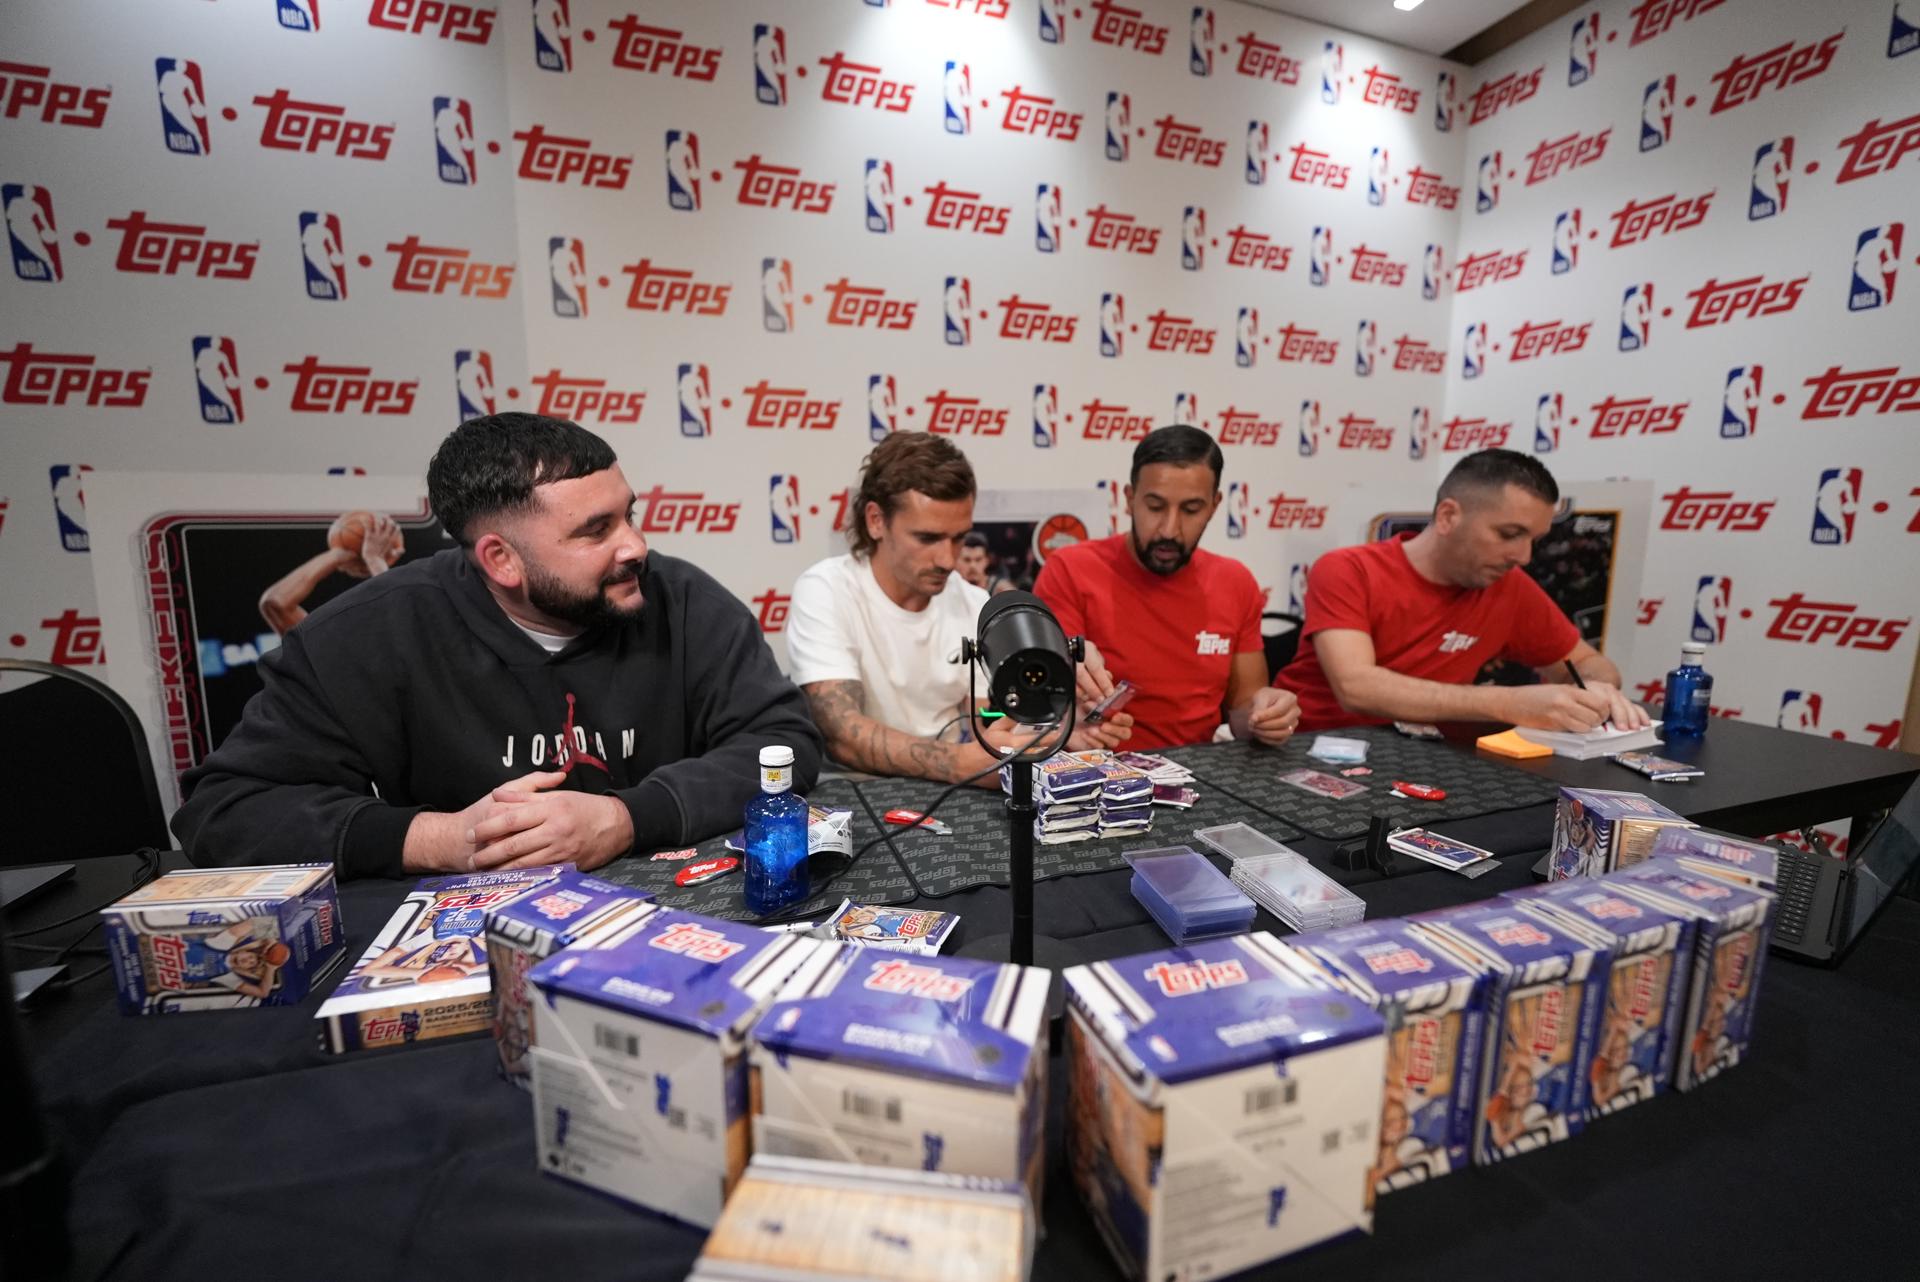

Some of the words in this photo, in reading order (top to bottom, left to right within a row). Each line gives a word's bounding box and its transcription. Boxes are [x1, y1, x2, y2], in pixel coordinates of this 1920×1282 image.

[609, 15, 721, 81] Topps
[1092, 0, 1168, 55] Topps
[0, 62, 111, 128] pps
[819, 52, 914, 113] Topps
[1363, 65, 1420, 113] Topps
[1467, 68, 1542, 126] Topps
[1712, 33, 1842, 115] Topps
[254, 89, 395, 160] Topps
[1001, 85, 1083, 142] Topps
[170, 132, 196, 152] NBA
[514, 125, 634, 190] Topps
[1155, 115, 1226, 167] Topps
[1525, 132, 1609, 186] Topps
[1836, 114, 1920, 185] Top
[735, 154, 836, 214] Topps
[1289, 144, 1348, 189] Topps
[924, 181, 1011, 236] Topps
[1087, 204, 1160, 255] Topps
[1610, 192, 1714, 249] Topps
[20, 259, 48, 279] NBA
[108, 212, 259, 280] Topps
[387, 236, 513, 298] Topps
[1226, 224, 1291, 272] Topps
[310, 279, 335, 298] NBA
[623, 258, 732, 316] Topps
[1455, 249, 1526, 292] Topps
[824, 278, 918, 331] Topps
[998, 294, 1078, 343] Topps
[1686, 276, 1808, 329] Topps
[1852, 292, 1879, 309] NBA
[1147, 308, 1216, 355] Topps
[1279, 324, 1338, 365] Topps
[1510, 321, 1590, 362] Topps
[0, 344, 150, 407] Topps
[284, 356, 418, 415] Topps
[532, 369, 646, 424] Topps
[206, 404, 231, 420] NBA
[743, 380, 841, 430] Topps
[924, 389, 1008, 437] Topps
[1082, 399, 1153, 443] Topps
[1218, 404, 1280, 447] Topps
[1589, 395, 1688, 439] Topps
[1337, 414, 1393, 451] Topps
[1442, 414, 1512, 452] Topps
[639, 486, 742, 532] Topps
[1267, 492, 1327, 530] Topps
[1660, 486, 1774, 532] Topps
[1815, 527, 1838, 542] NBA
[1766, 593, 1908, 651] Topps
[502, 726, 635, 768] JORDAN
[901, 844, 941, 858] Topps
[916, 865, 960, 882] Topps
[931, 853, 975, 864] Topps
[1058, 861, 1102, 872] Topps
[870, 877, 910, 888] Topps
[950, 874, 992, 888] Topps
[686, 898, 731, 913] Topps
[153, 934, 188, 992] Topps
[869, 961, 968, 998] Topps
[1148, 962, 1244, 994] Topps
[364, 1018, 418, 1041] Topp
